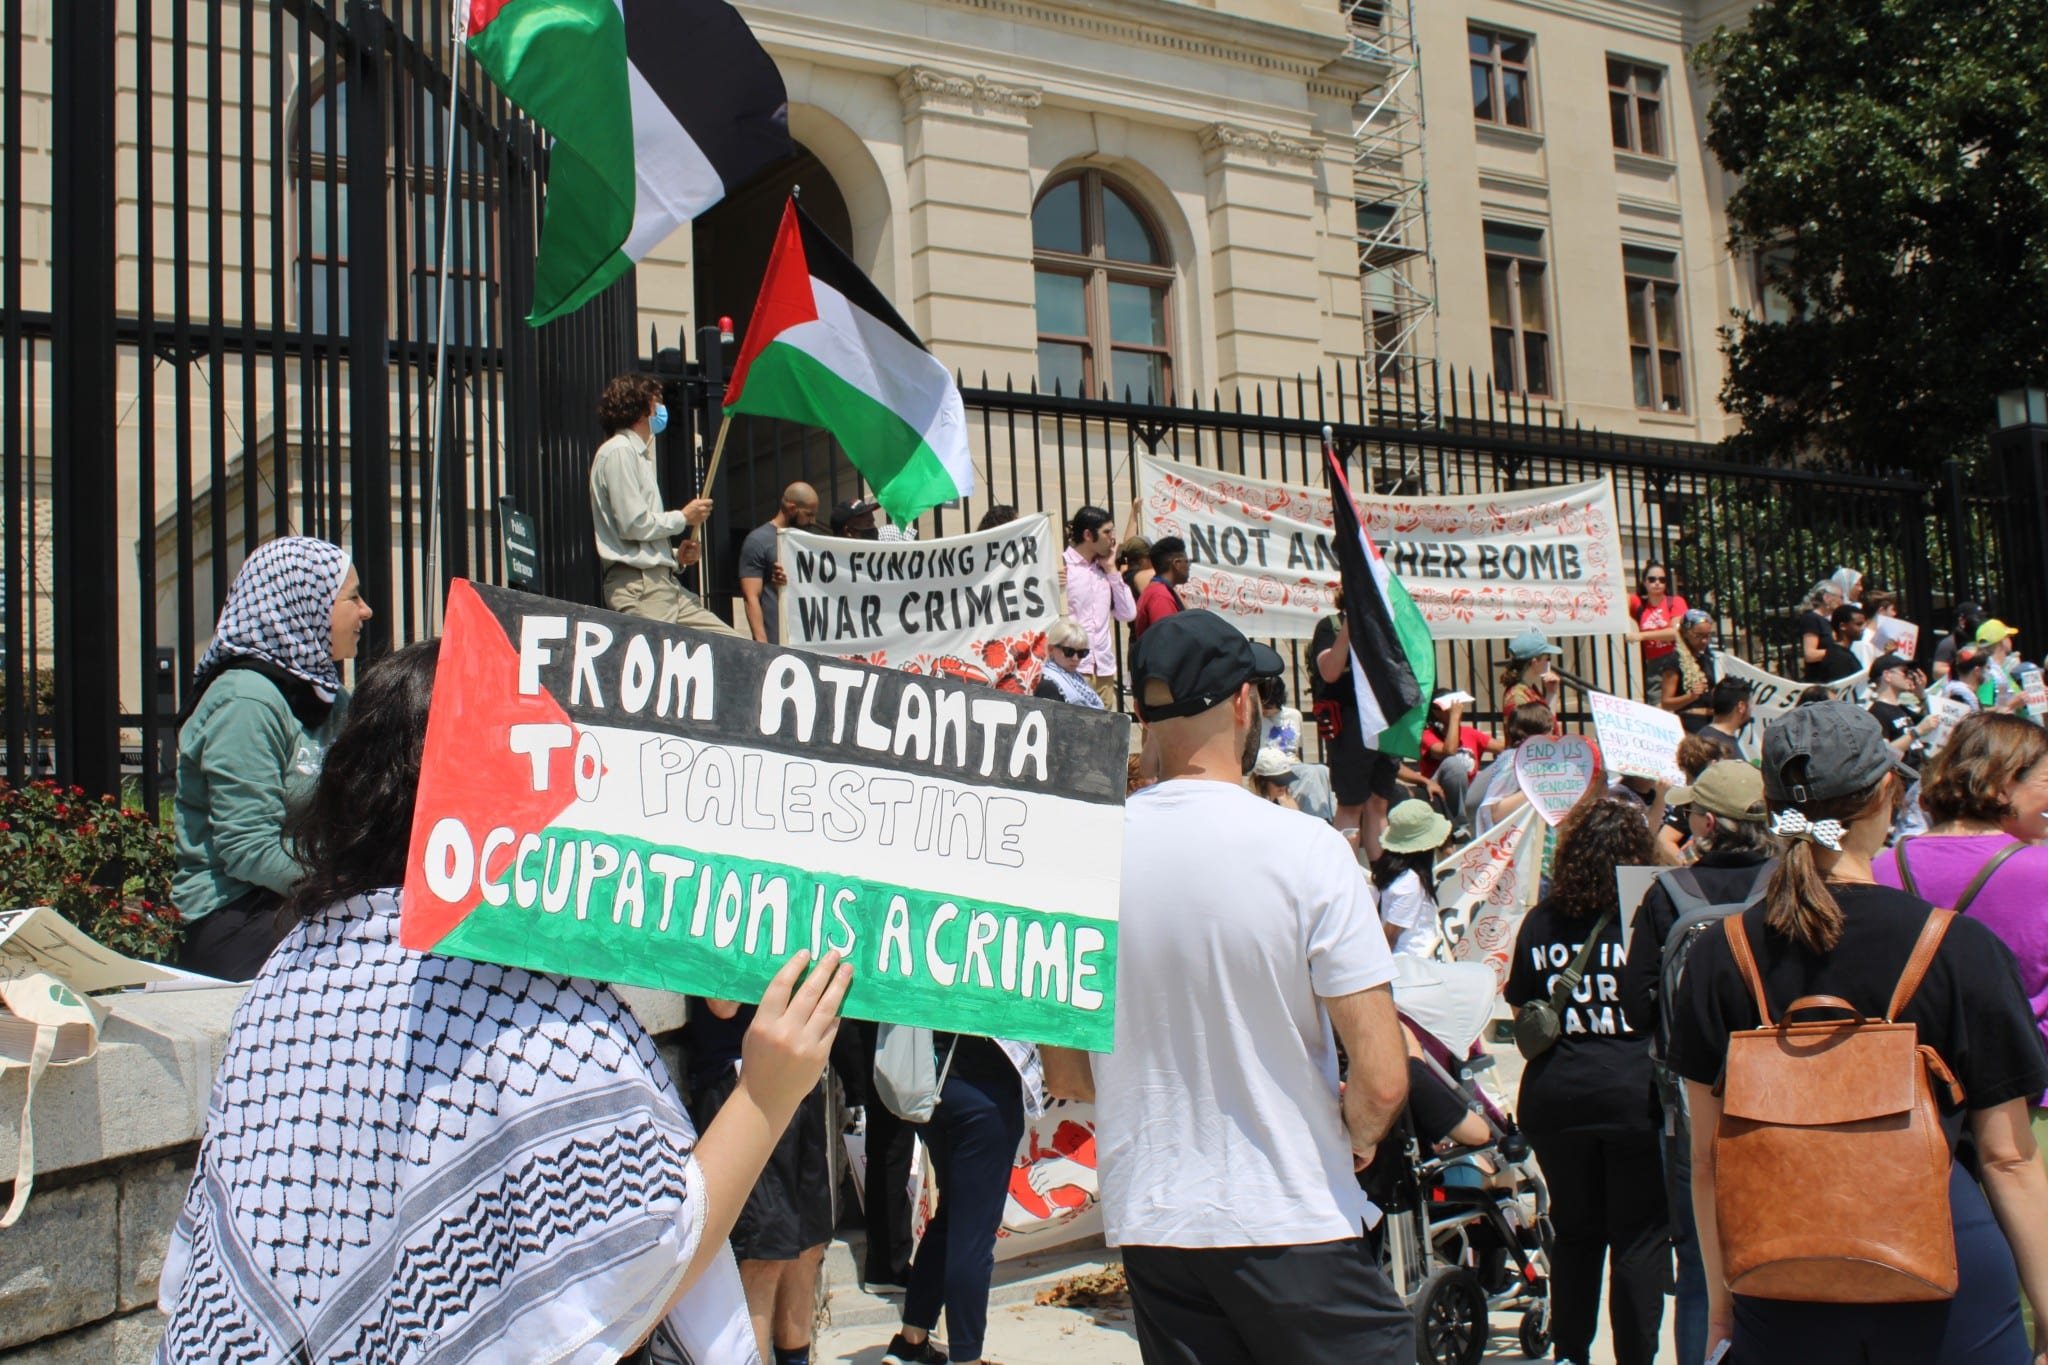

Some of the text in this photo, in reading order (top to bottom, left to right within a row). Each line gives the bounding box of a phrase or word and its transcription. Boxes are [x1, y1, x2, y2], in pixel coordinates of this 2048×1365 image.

[796, 535, 1039, 583] NO FUNDING FOR
[1190, 523, 1584, 580] NOT ANTHER BOMB
[798, 576, 1045, 642] WAR CRIMES
[518, 614, 1050, 782] FROM ATLANTA
[1592, 694, 1632, 714] FREE
[1596, 711, 1678, 743] PALESTINE
[1600, 728, 1629, 747] END
[1526, 741, 1583, 758] END US
[1522, 760, 1569, 777] SUPPORT
[509, 722, 1028, 868] TO PALESTINE
[424, 817, 1106, 1012] OCCUPATION IS A CRIME
[1531, 943, 1628, 971] NOT IN
[1547, 974, 1619, 1003] OUR
